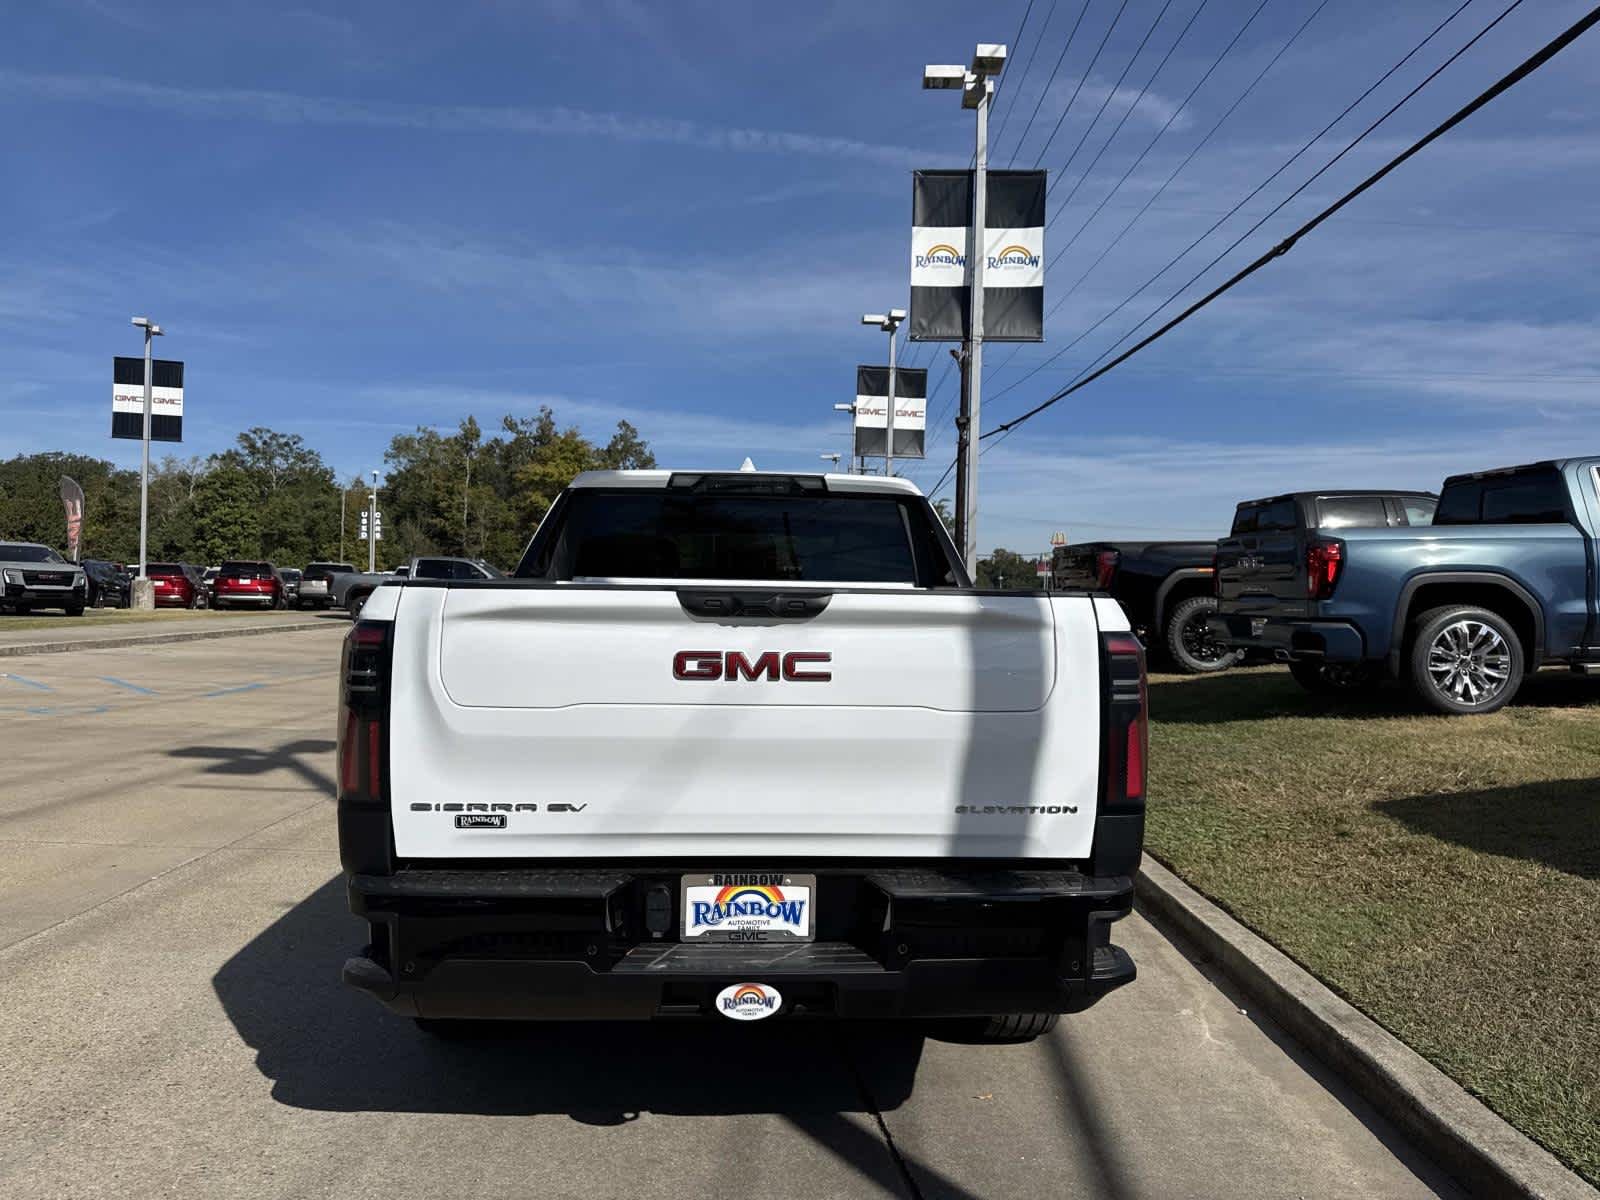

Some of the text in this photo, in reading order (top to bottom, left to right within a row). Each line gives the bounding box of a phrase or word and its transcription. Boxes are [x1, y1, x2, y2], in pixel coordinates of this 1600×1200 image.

[915, 255, 967, 269] RAINBOW
[987, 256, 1041, 269] RAINBOW
[115, 394, 144, 403] GMC
[153, 397, 181, 405] GMC
[858, 408, 886, 416] GMC
[672, 651, 832, 682] GMC
[410, 803, 587, 812] SIERRA EV
[955, 806, 1078, 815] ELEVATION
[460, 815, 500, 826] RAINBOW
[714, 874, 784, 886] RAINBOW
[692, 900, 806, 928] RAINBOW
[728, 931, 768, 941] GMC
[723, 996, 776, 1010] RAINBOW
